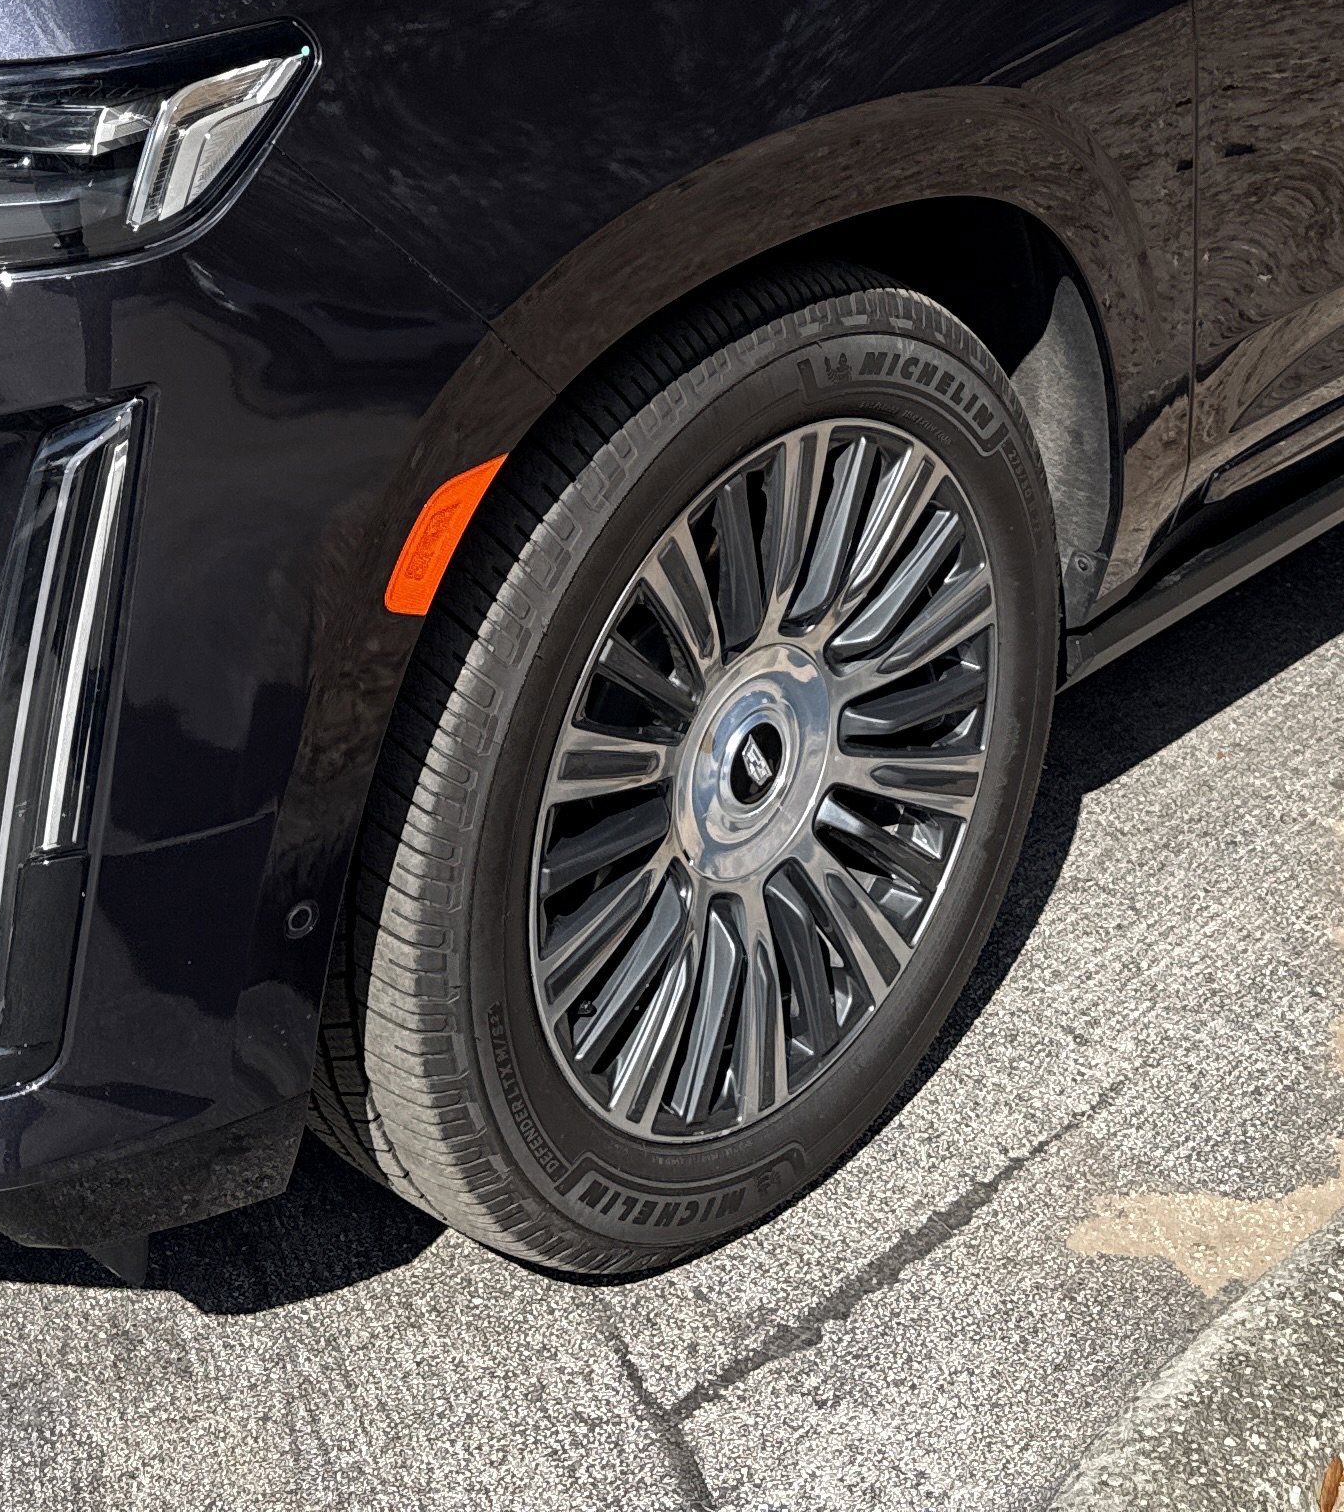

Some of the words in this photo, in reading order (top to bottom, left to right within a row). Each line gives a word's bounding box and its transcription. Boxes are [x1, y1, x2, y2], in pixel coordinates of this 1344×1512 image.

[858, 351, 994, 431] MICHELIN
[500, 1064, 522, 1098] LTX
[512, 1099, 560, 1174] DEFENDER
[578, 1179, 747, 1227] MICHELIN
